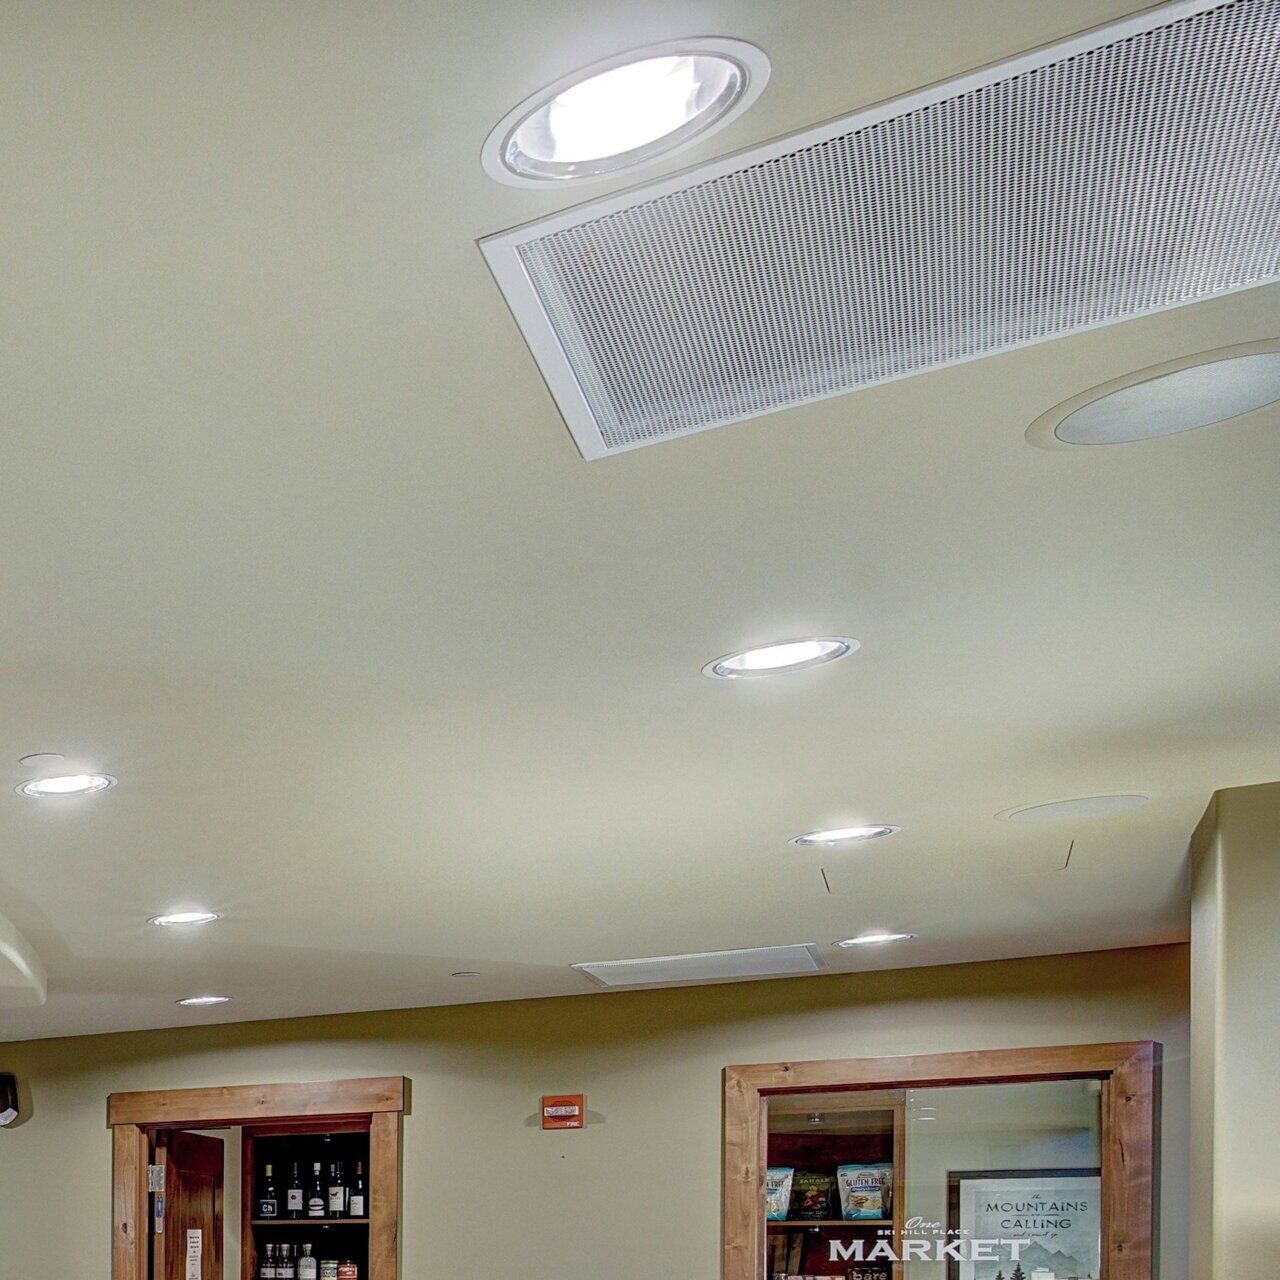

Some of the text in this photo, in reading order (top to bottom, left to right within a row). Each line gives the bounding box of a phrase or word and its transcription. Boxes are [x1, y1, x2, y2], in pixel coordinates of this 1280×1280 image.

[845, 1177, 886, 1187] GLUTEN FREE
[262, 1204, 273, 1212] Ch
[985, 1202, 1088, 1212] MOUNTAINS
[904, 1216, 941, 1230] One
[1001, 1219, 1072, 1229] CALLING
[828, 1239, 1031, 1261] MARKET
[852, 1271, 887, 1280] bare
